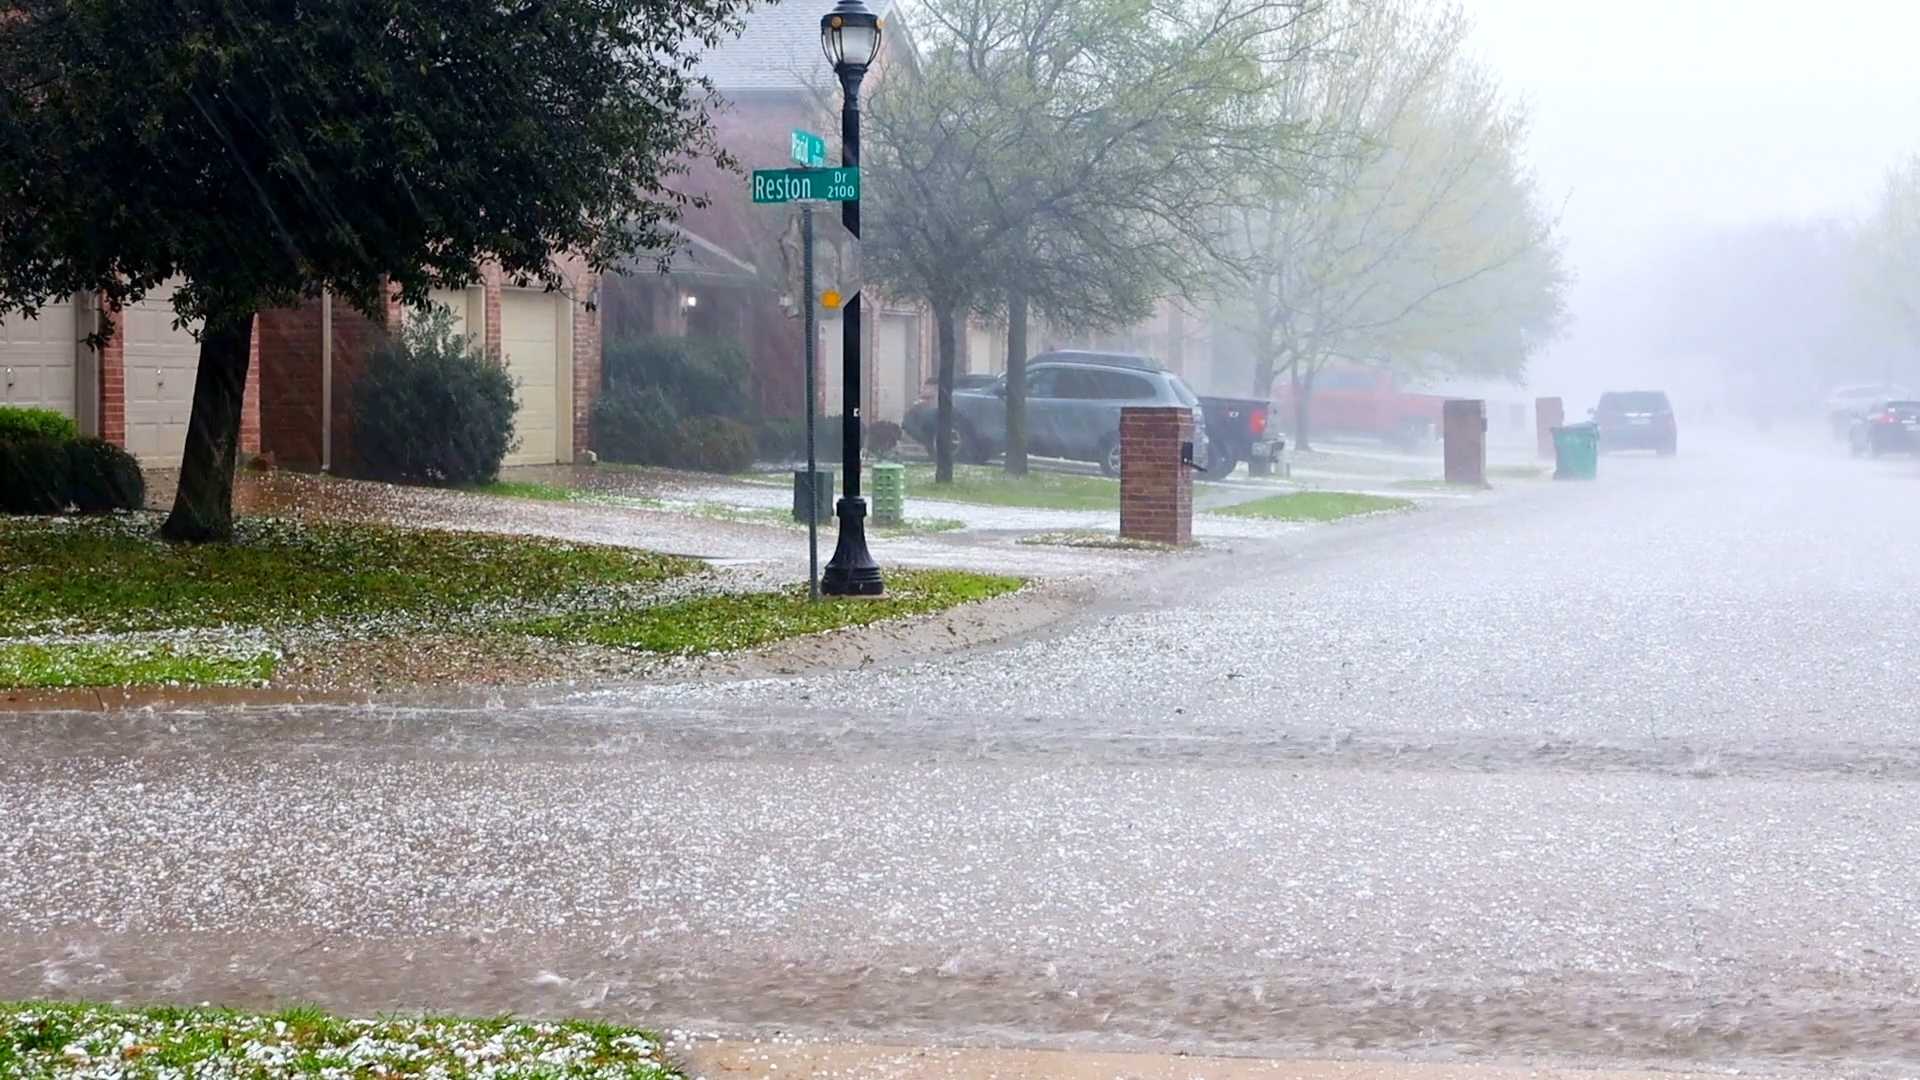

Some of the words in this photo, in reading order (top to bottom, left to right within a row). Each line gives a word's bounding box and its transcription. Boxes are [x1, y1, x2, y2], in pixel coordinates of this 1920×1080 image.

[755, 174, 811, 199] Reston
[834, 171, 848, 183] Dr
[827, 185, 855, 198] 2100
